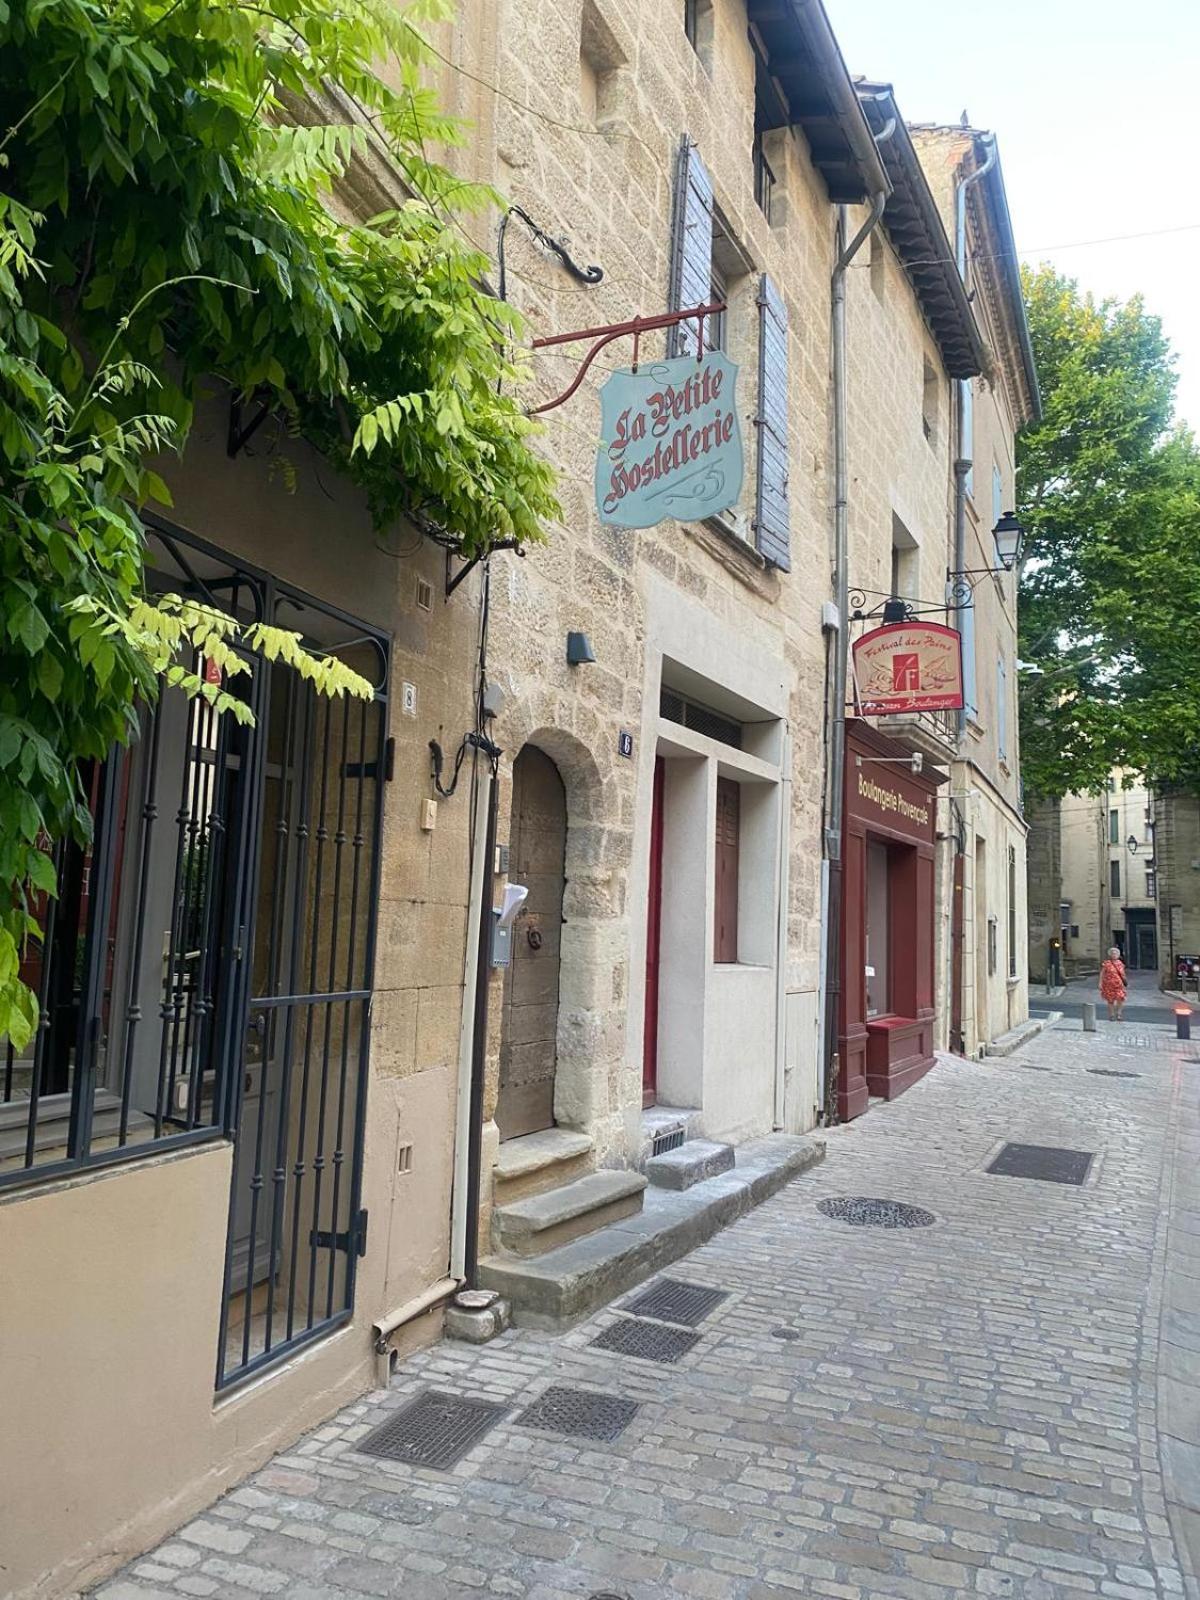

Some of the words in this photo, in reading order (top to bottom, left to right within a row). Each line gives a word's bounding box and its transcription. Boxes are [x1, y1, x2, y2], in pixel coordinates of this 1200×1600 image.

[608, 406, 646, 460] La
[646, 366, 723, 438] Petite
[603, 409, 734, 514] Hostellerie
[864, 636, 903, 658] Festival
[905, 636, 921, 646] des
[923, 635, 952, 651] Pains
[406, 690, 413, 707] 8
[903, 697, 954, 711] Boulanger
[624, 735, 631, 754] 6
[858, 773, 898, 811] Boulangerie
[897, 793, 929, 827] Provençale
